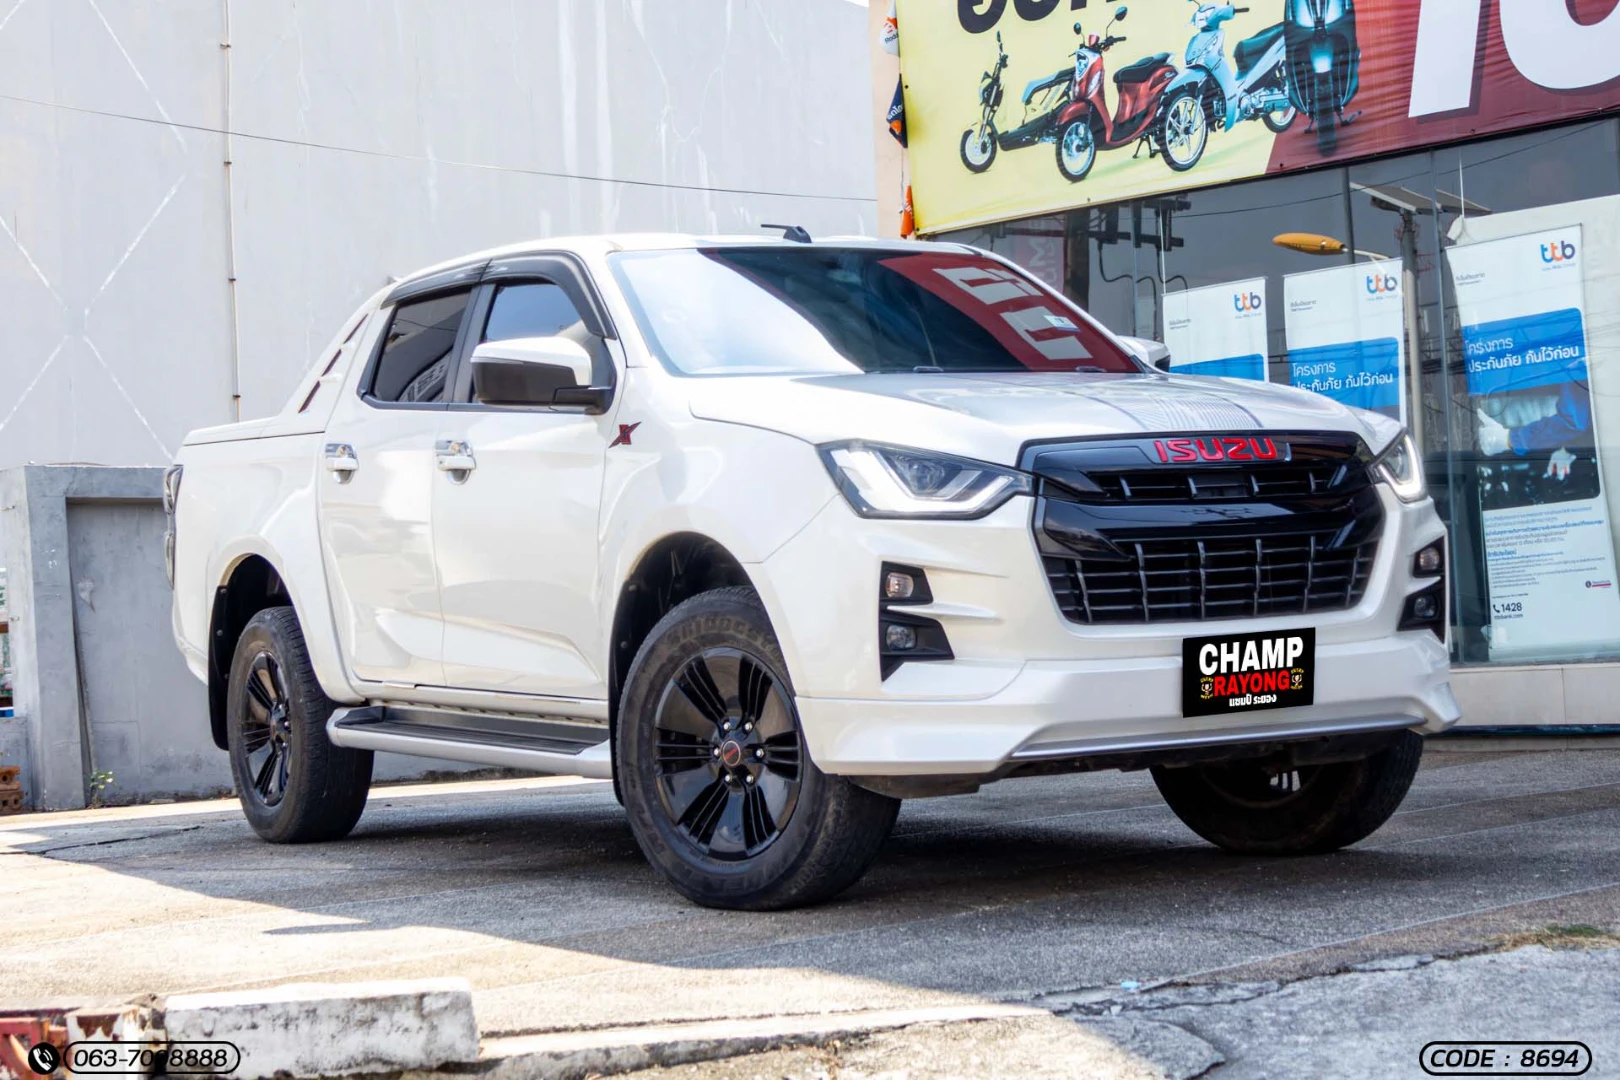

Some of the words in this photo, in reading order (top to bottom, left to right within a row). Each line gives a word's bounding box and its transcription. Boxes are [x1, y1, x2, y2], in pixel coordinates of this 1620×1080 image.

[1540, 240, 1576, 263] ttb
[1366, 274, 1398, 294] ttb
[1234, 291, 1262, 312] ttb
[1468, 352, 1522, 373] ประกันภัย
[1525, 344, 1580, 365] กันไว้ก่อน
[1292, 361, 1336, 378] โครงการ
[1153, 437, 1278, 464] ISUZU
[1501, 602, 1523, 613] 1428
